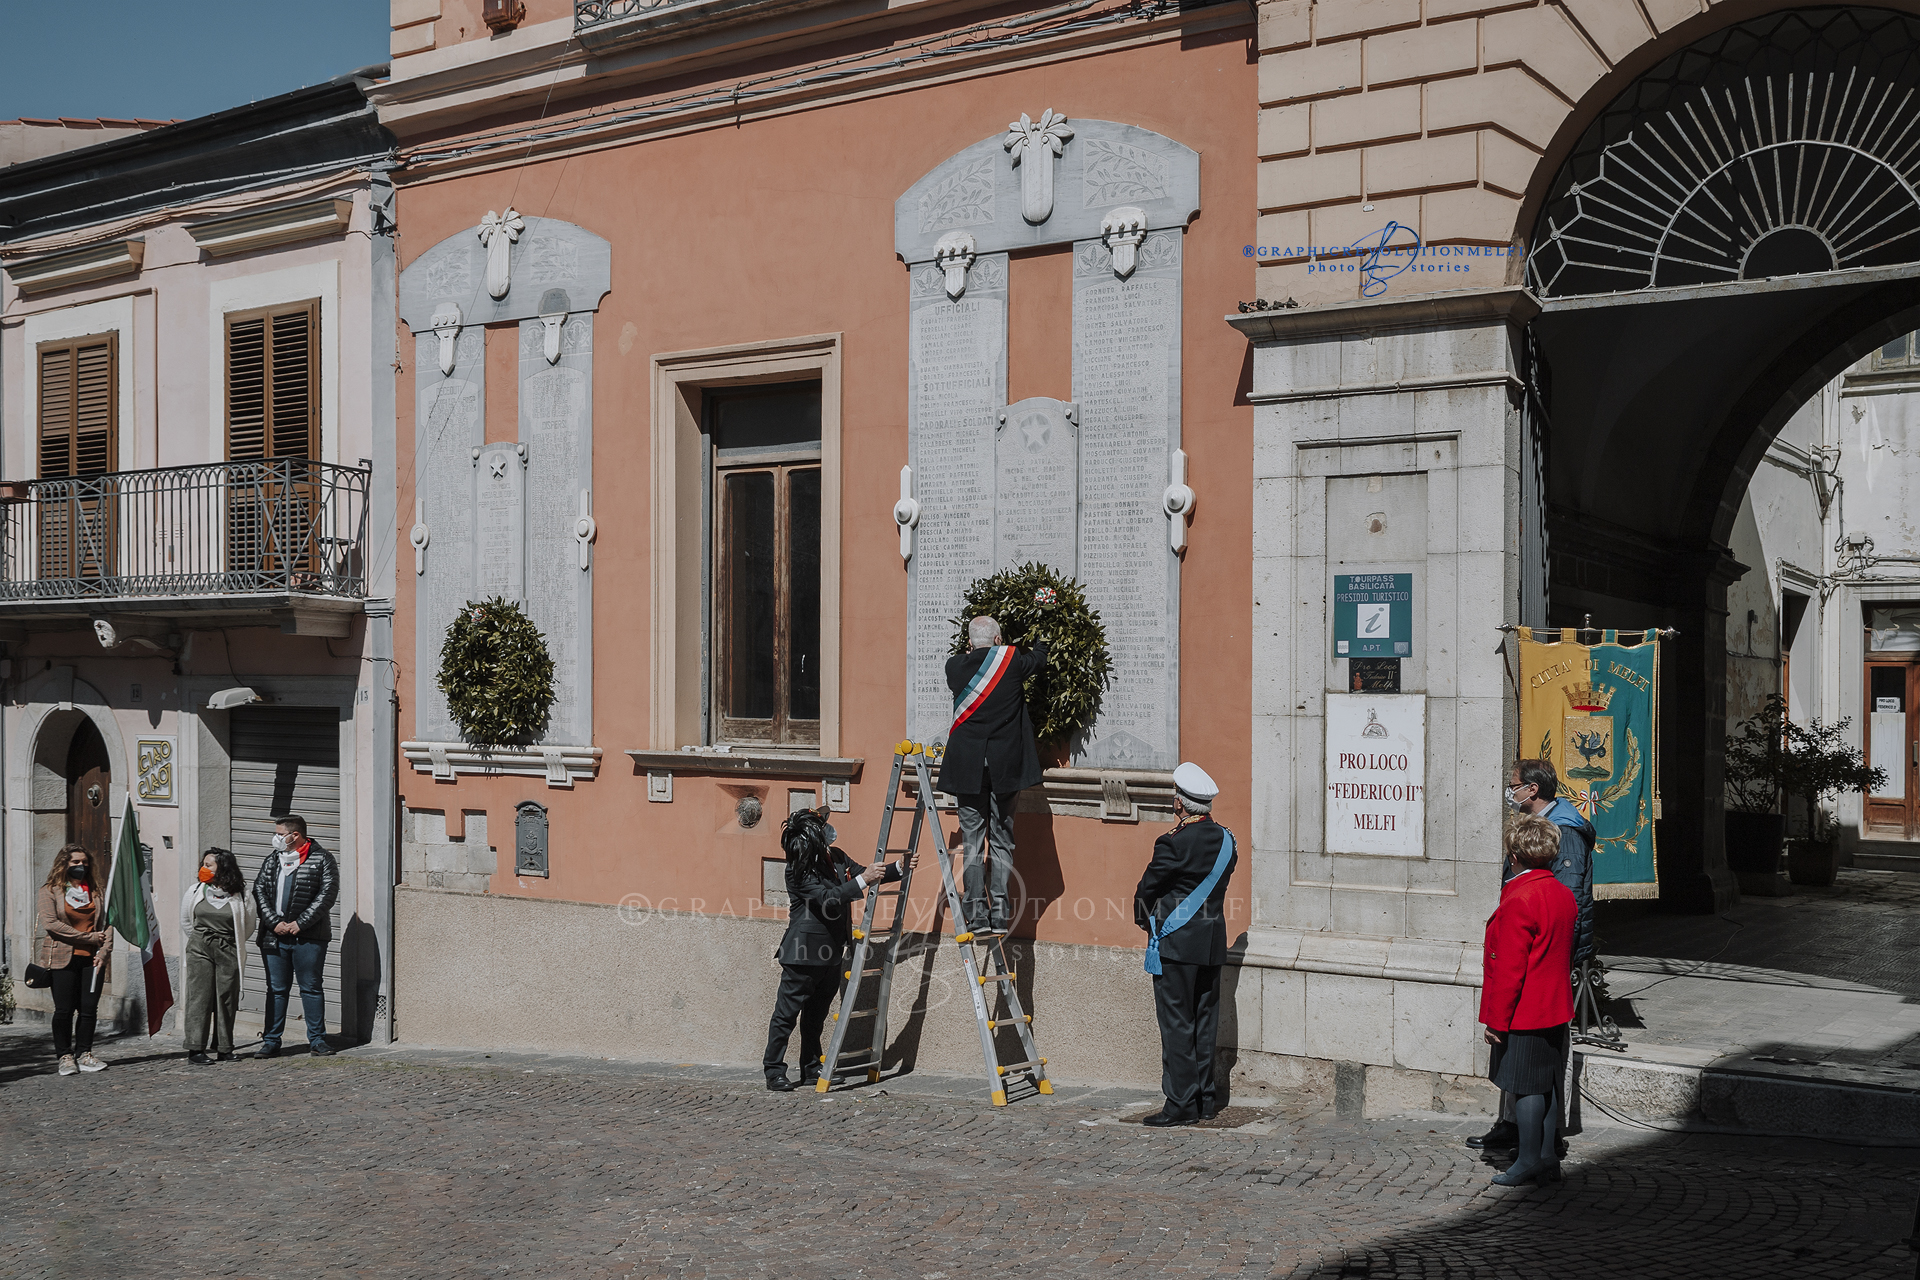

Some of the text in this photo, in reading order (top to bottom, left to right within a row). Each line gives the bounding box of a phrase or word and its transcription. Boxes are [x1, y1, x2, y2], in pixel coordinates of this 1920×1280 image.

[1122, 282, 1156, 292] RAFFAELE
[935, 302, 980, 315] UFFICIALI
[1124, 299, 1161, 308] SALVATORE
[1107, 310, 1132, 318] MICHELE
[1111, 318, 1148, 327] SALVATORE
[1101, 370, 1140, 378] ALESSANDRO
[924, 377, 990, 392] SOTTUFFICIALI
[1118, 386, 1147, 394] GIOVANNI
[919, 416, 993, 430] CAPORALI SOLDATI
[1348, 582, 1395, 590] BASILICATA
[1337, 591, 1409, 602] PRESIDIO TURISTICO
[1584, 659, 1600, 671] DI
[1608, 660, 1650, 692] MELFI
[1368, 680, 1394, 690] Melfi
[139, 740, 172, 771] CIAO
[1340, 753, 1408, 771] PRO LOCO
[138, 768, 169, 799] CIAO
[1354, 813, 1396, 831] MELFI
